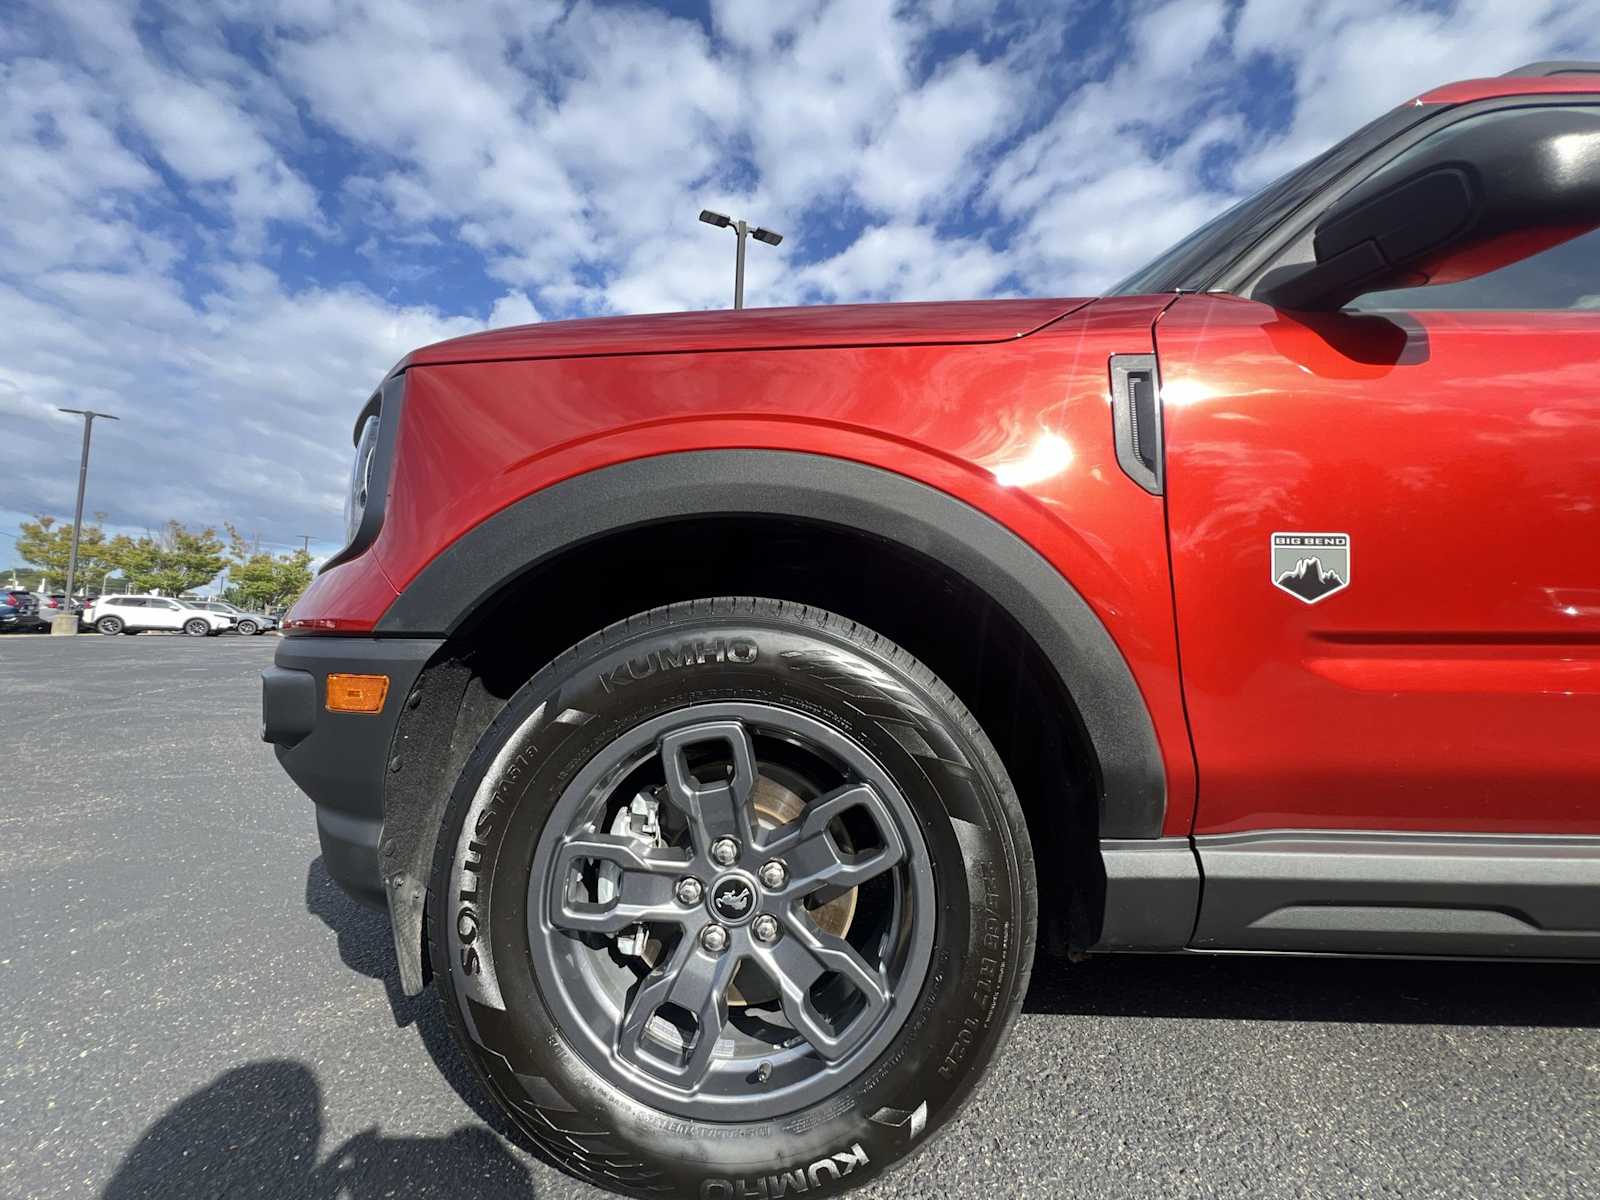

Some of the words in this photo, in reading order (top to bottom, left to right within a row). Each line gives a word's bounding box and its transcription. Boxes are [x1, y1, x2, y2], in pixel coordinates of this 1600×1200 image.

[1275, 537, 1302, 546] BIG
[1304, 537, 1346, 546] BEND
[599, 638, 758, 693] KUMHO
[456, 809, 492, 976] SOLUS
[703, 1143, 870, 1200] KUMHO
